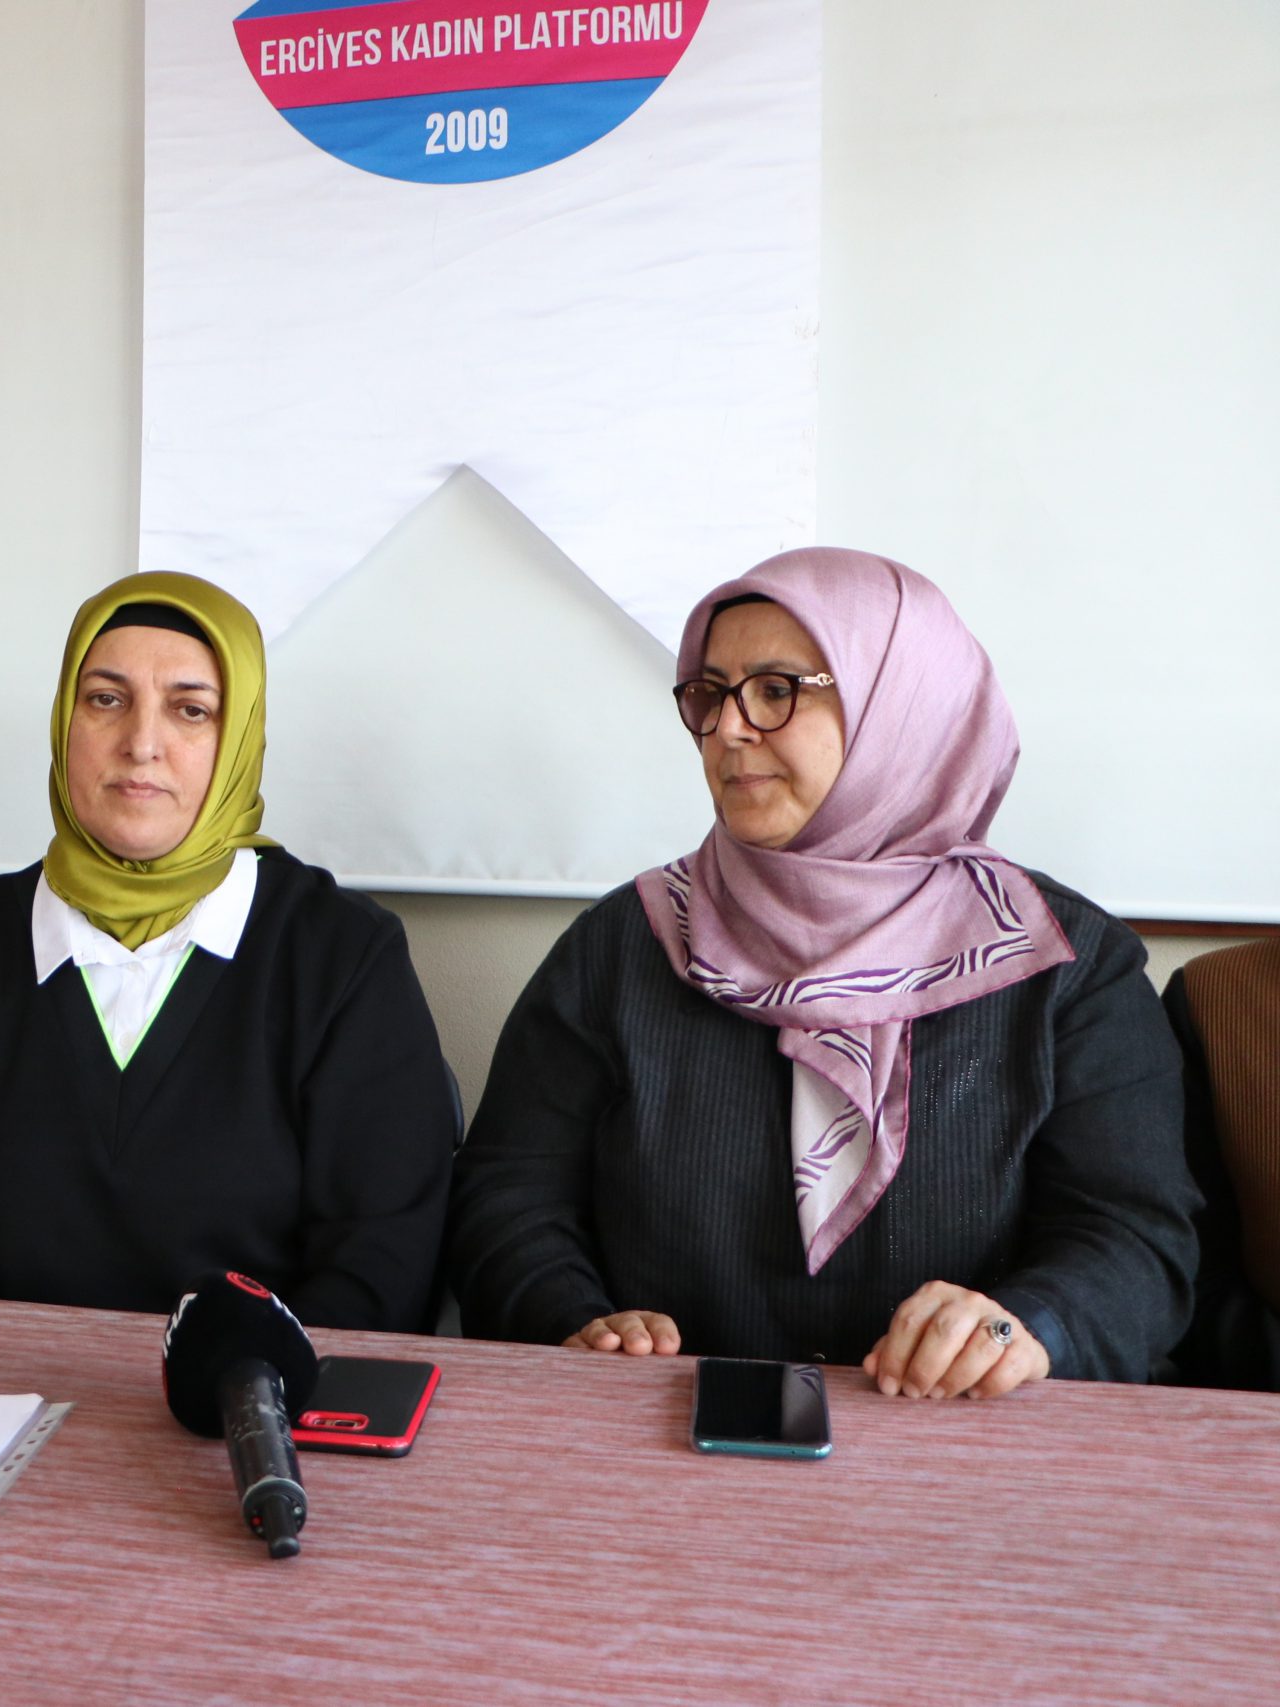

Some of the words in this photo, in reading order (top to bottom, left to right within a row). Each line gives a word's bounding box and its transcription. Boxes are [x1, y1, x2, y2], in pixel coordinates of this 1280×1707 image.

[260, 28, 382, 76] ERCİYES
[391, 16, 484, 62] KADIN
[494, 1, 683, 52] PLATFORMU
[425, 107, 508, 155] 2009
